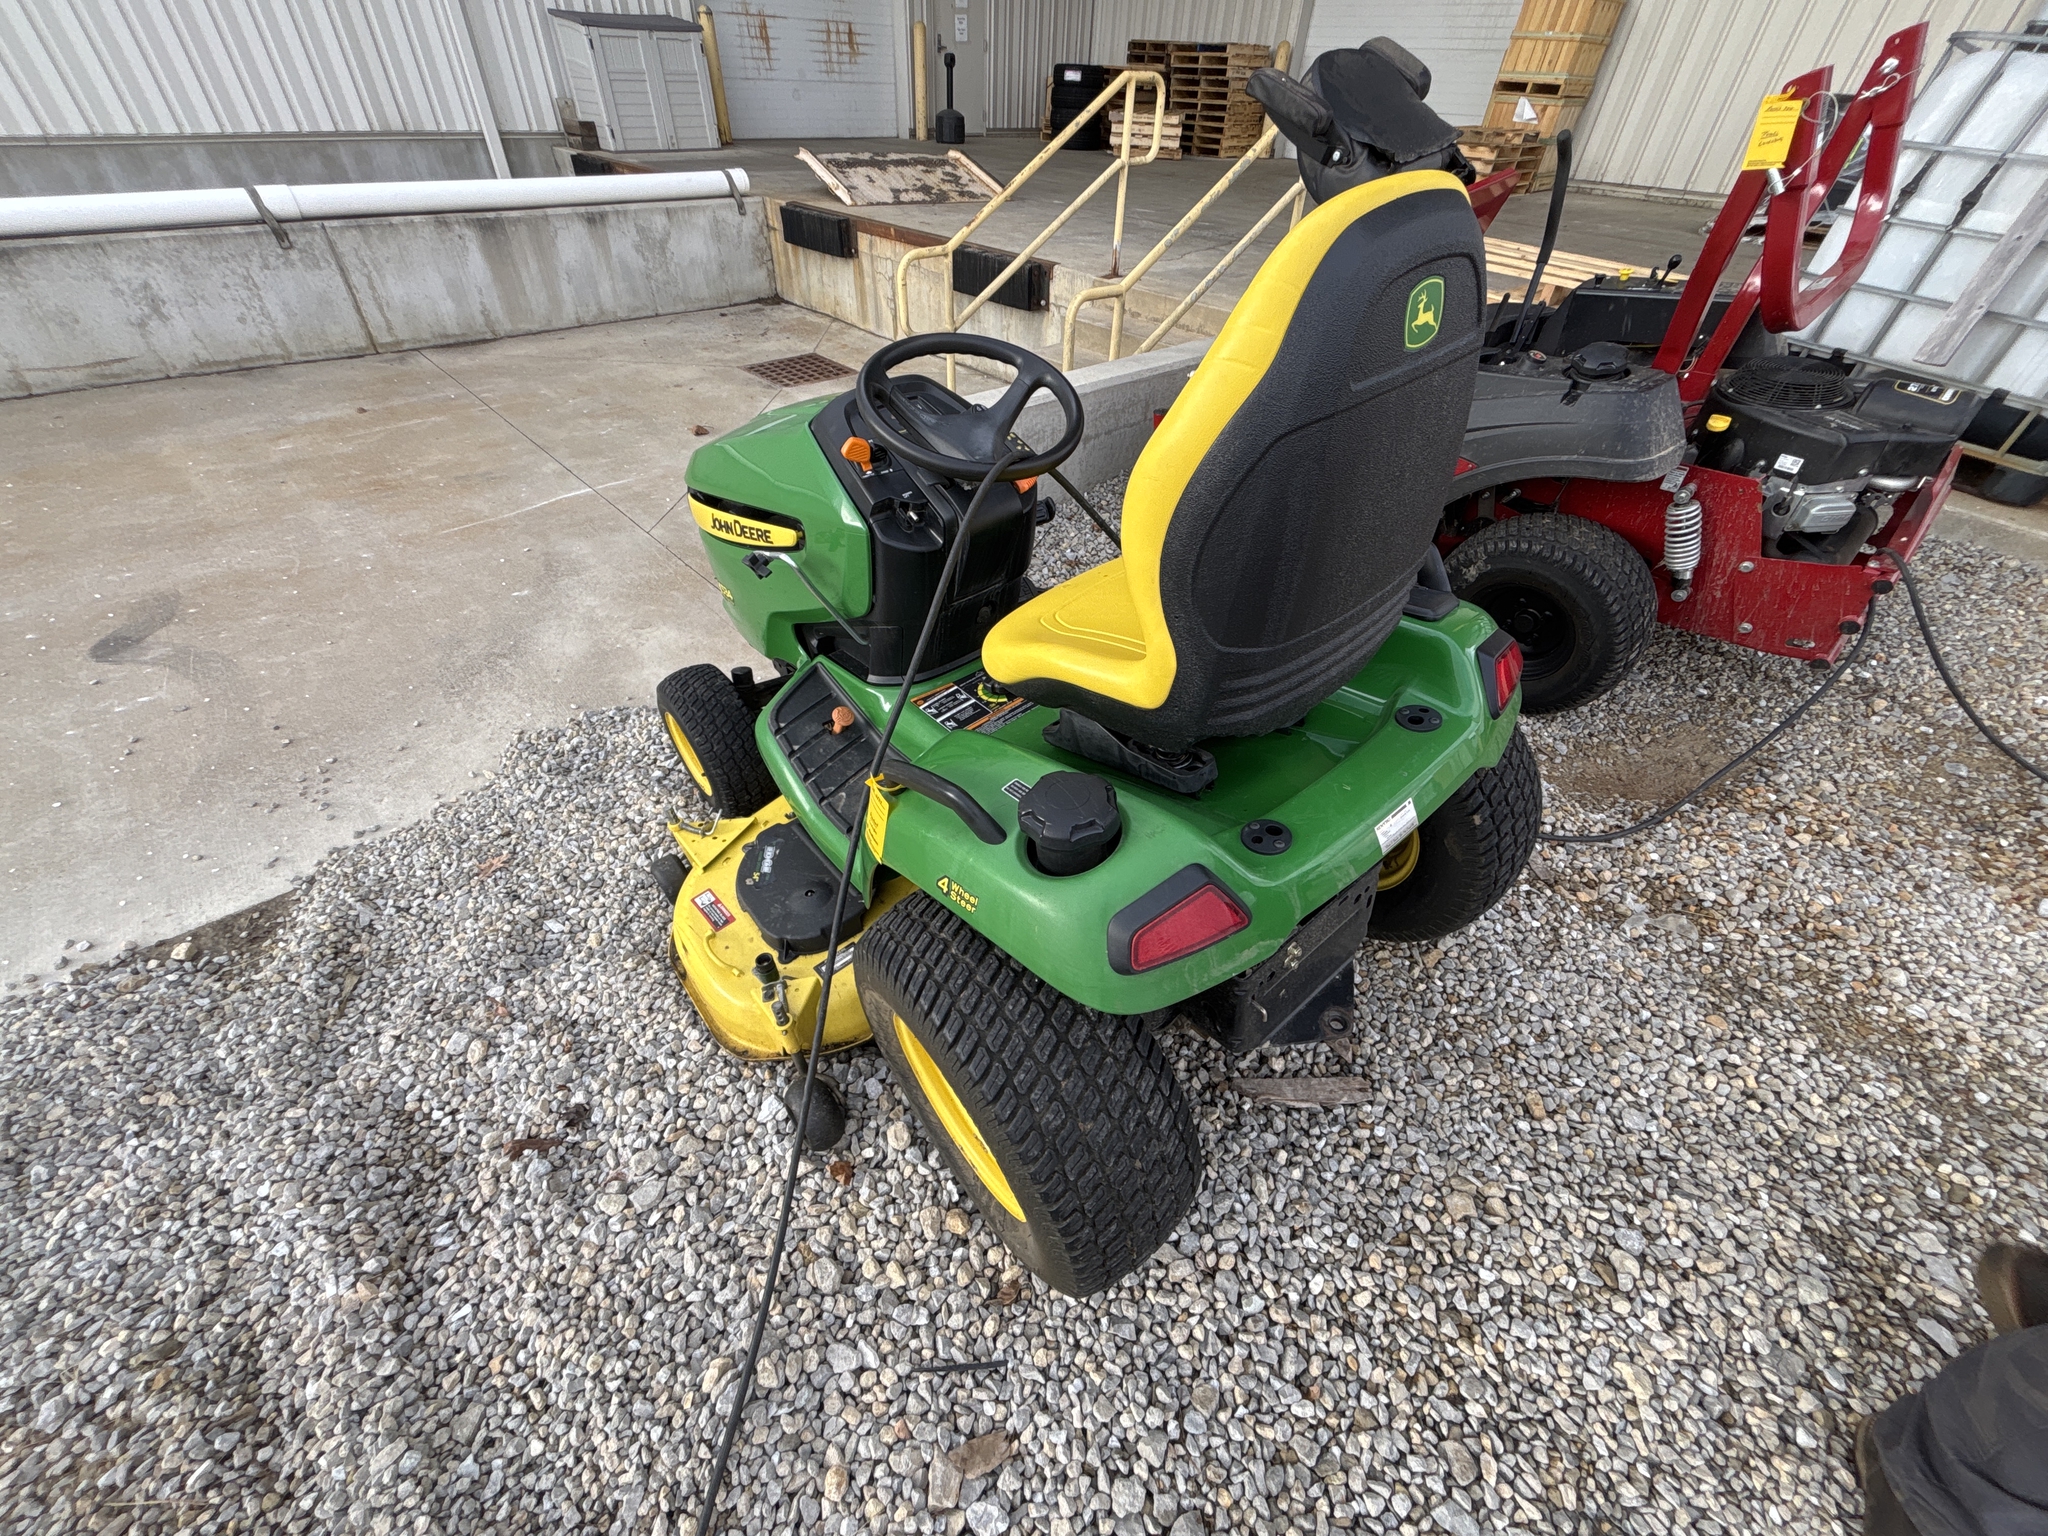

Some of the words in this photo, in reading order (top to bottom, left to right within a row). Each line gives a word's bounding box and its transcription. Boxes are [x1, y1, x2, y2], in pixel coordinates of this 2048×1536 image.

[711, 513, 734, 535] JOHN
[734, 519, 774, 544] DEERE
[937, 877, 949, 894] 4
[951, 881, 979, 906] Wheel
[950, 890, 976, 913] Steer
